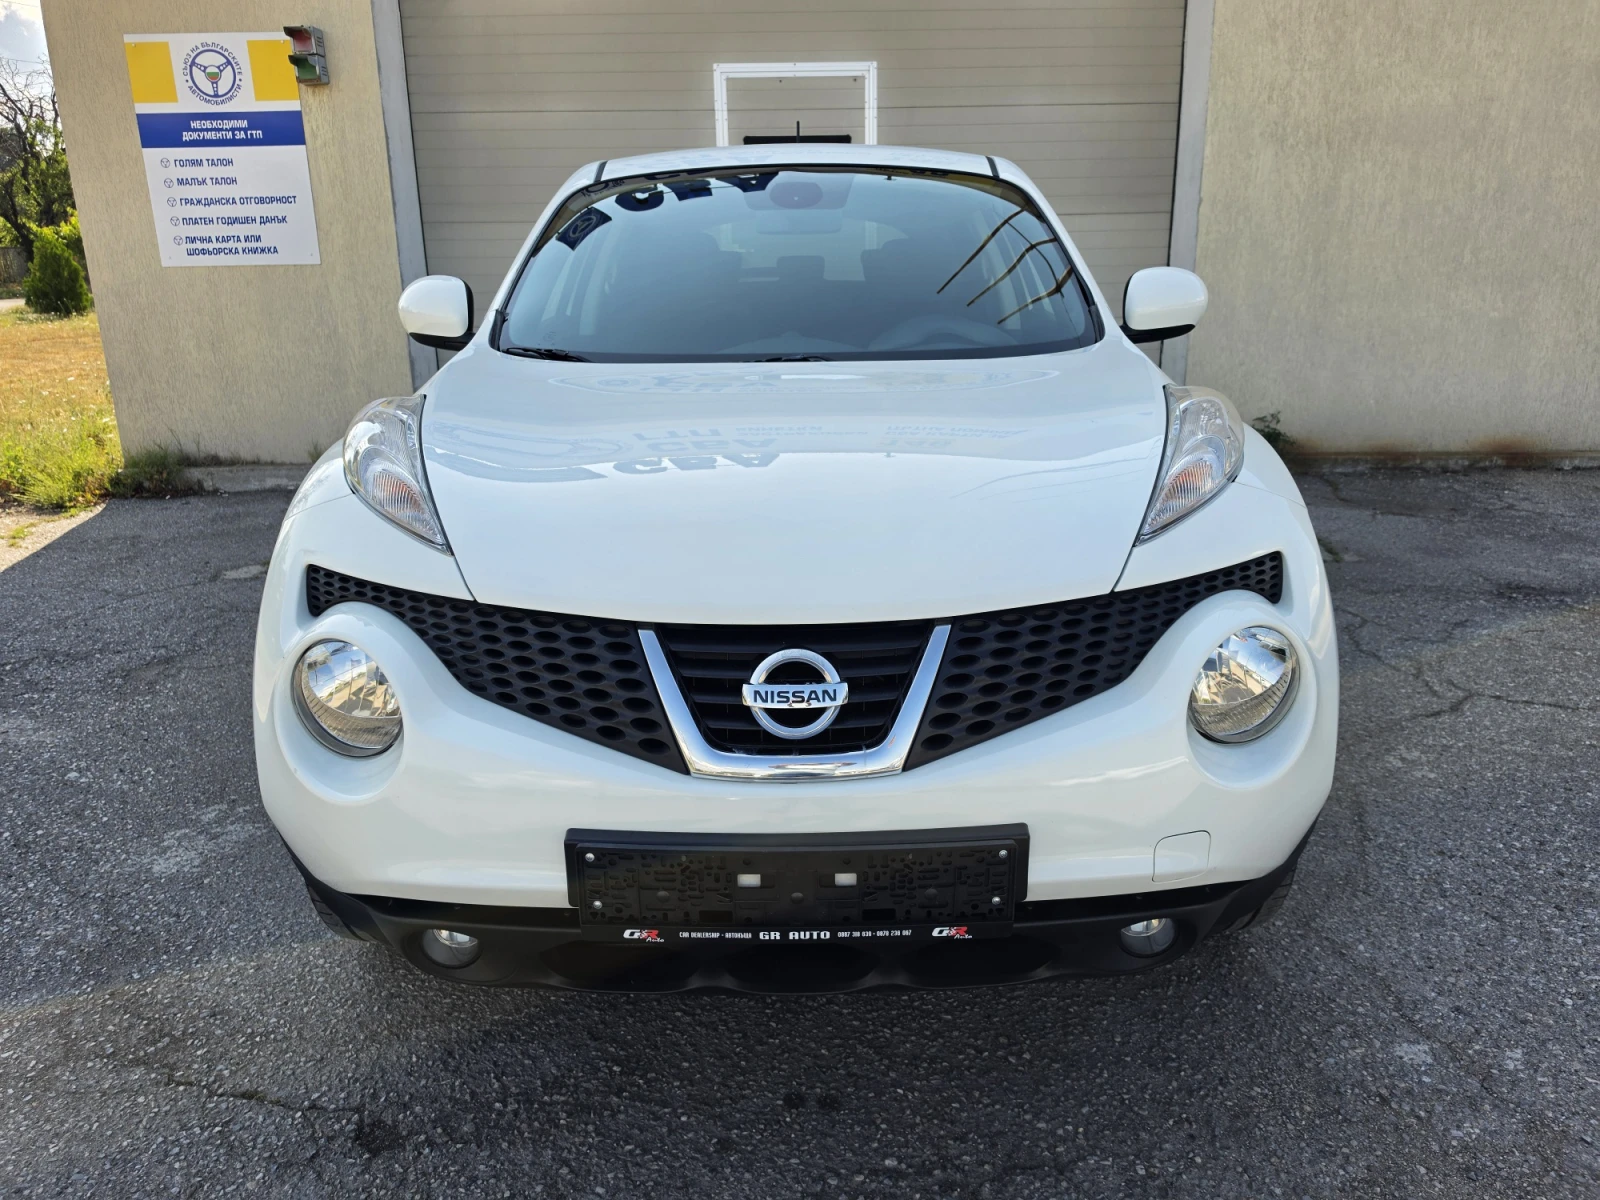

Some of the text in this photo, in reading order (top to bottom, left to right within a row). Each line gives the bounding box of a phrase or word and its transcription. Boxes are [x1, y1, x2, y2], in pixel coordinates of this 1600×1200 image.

[182, 42, 243, 77] СЪЮЗ НА БЪЛГАРСКИТЕ
[188, 83, 242, 106] АВТОМОБИЛИСТИ
[190, 119, 248, 130] НЕОБХОДИМИ
[182, 130, 263, 142] ДОКУМЕНТИ ЗА ГТП
[174, 158, 234, 168] ГОЛЯМ ТАЛОН
[176, 176, 238, 187] МАЛЪК ТАЛОН
[179, 195, 297, 207] ГРАЖДАНСКА ОТГОВОРНОСТ
[181, 215, 288, 226] ПЛАТЕН ГОДИШЕН ДАНЪК
[185, 235, 262, 244] ЛИЧНА КАРТА ИЛИ
[186, 246, 279, 256] ШОФЬОРСКА КНИЖКА
[753, 688, 837, 704] NISSAN
[690, 931, 720, 939] DEALERSHIP
[759, 931, 781, 940] GR
[788, 931, 831, 940] AUTO
